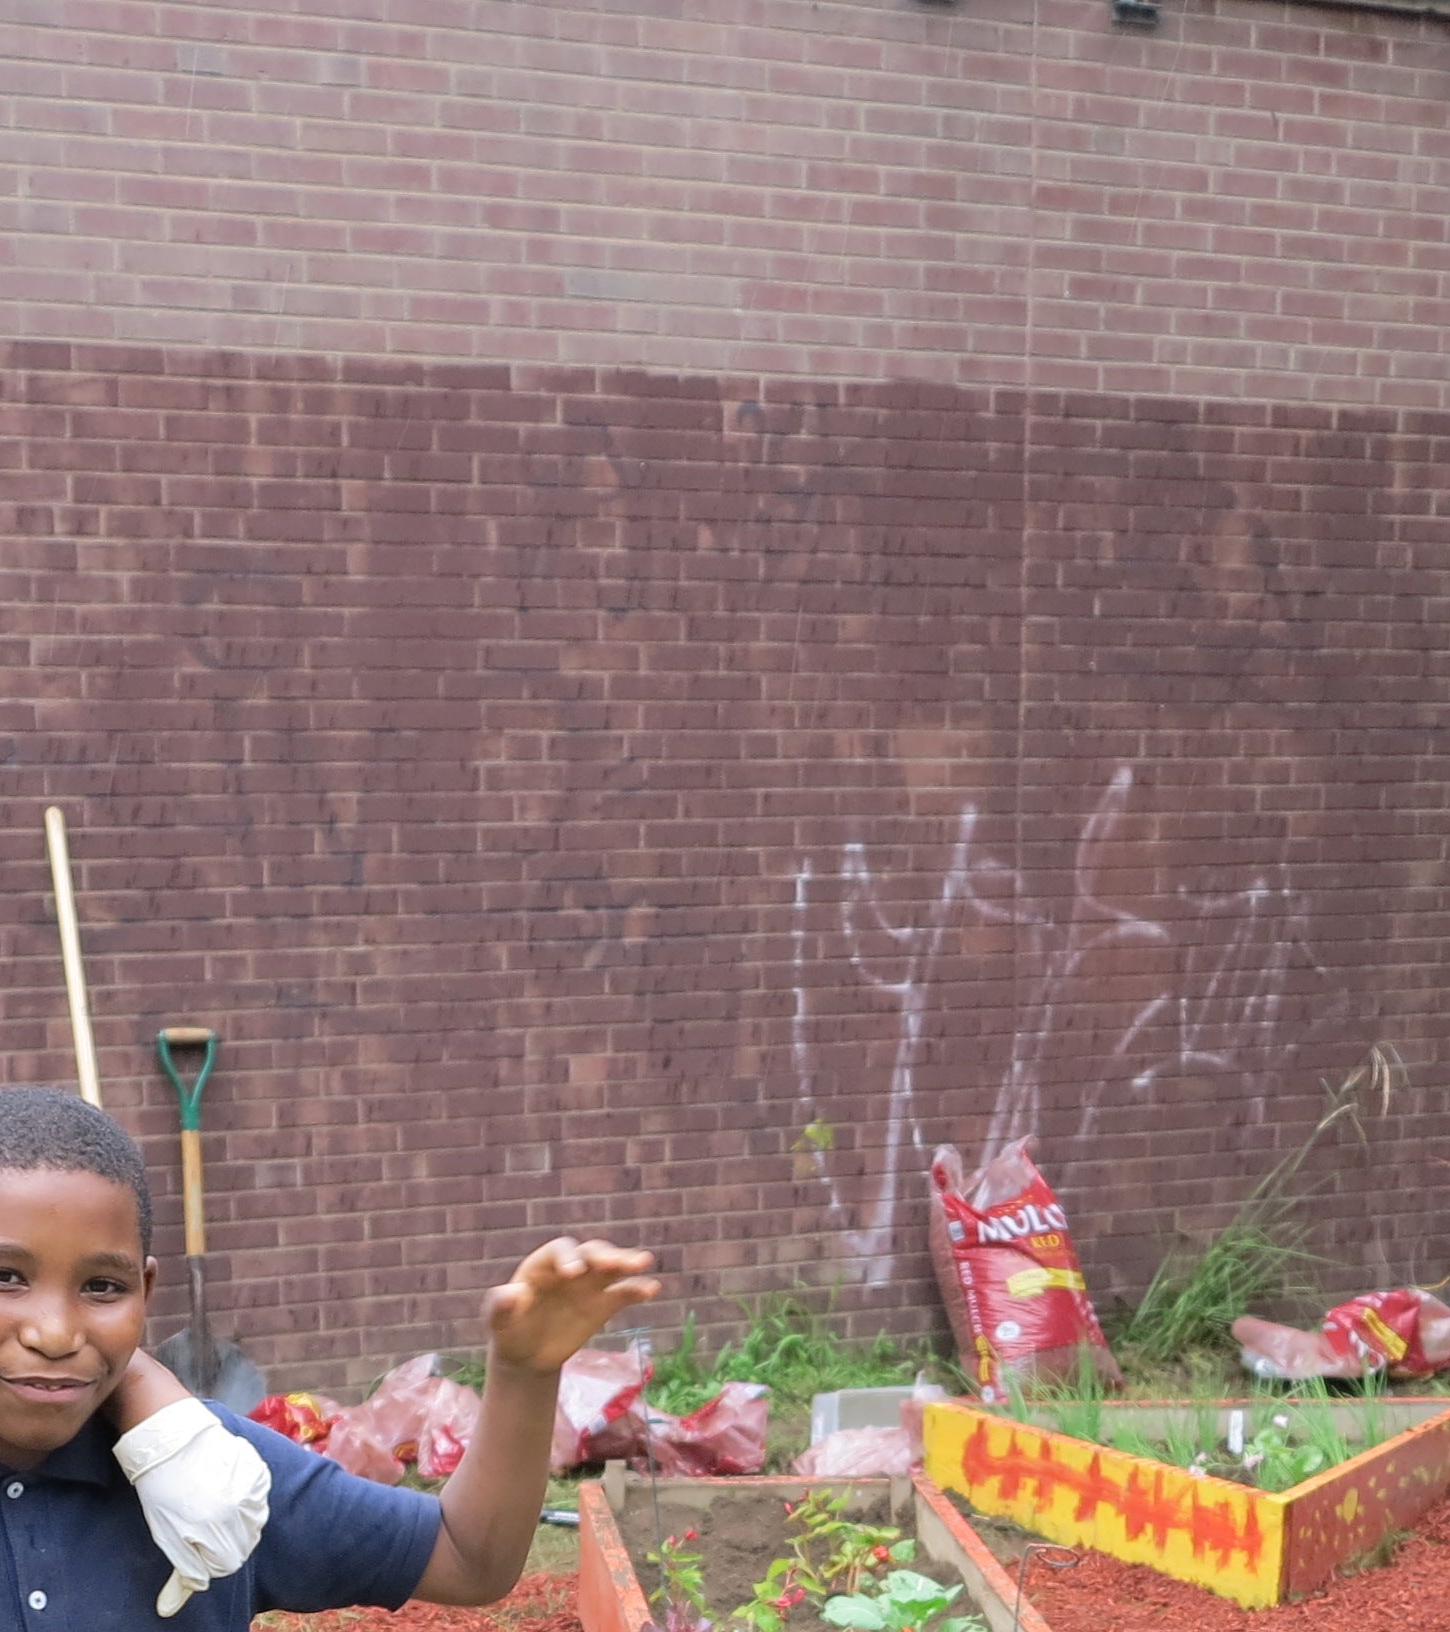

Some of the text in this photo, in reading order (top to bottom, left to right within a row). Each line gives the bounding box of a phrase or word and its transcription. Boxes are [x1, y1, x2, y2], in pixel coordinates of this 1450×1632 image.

[977, 1203, 1068, 1244] MULC
[1030, 1234, 1061, 1249] RED
[959, 1262, 973, 1285] RED
